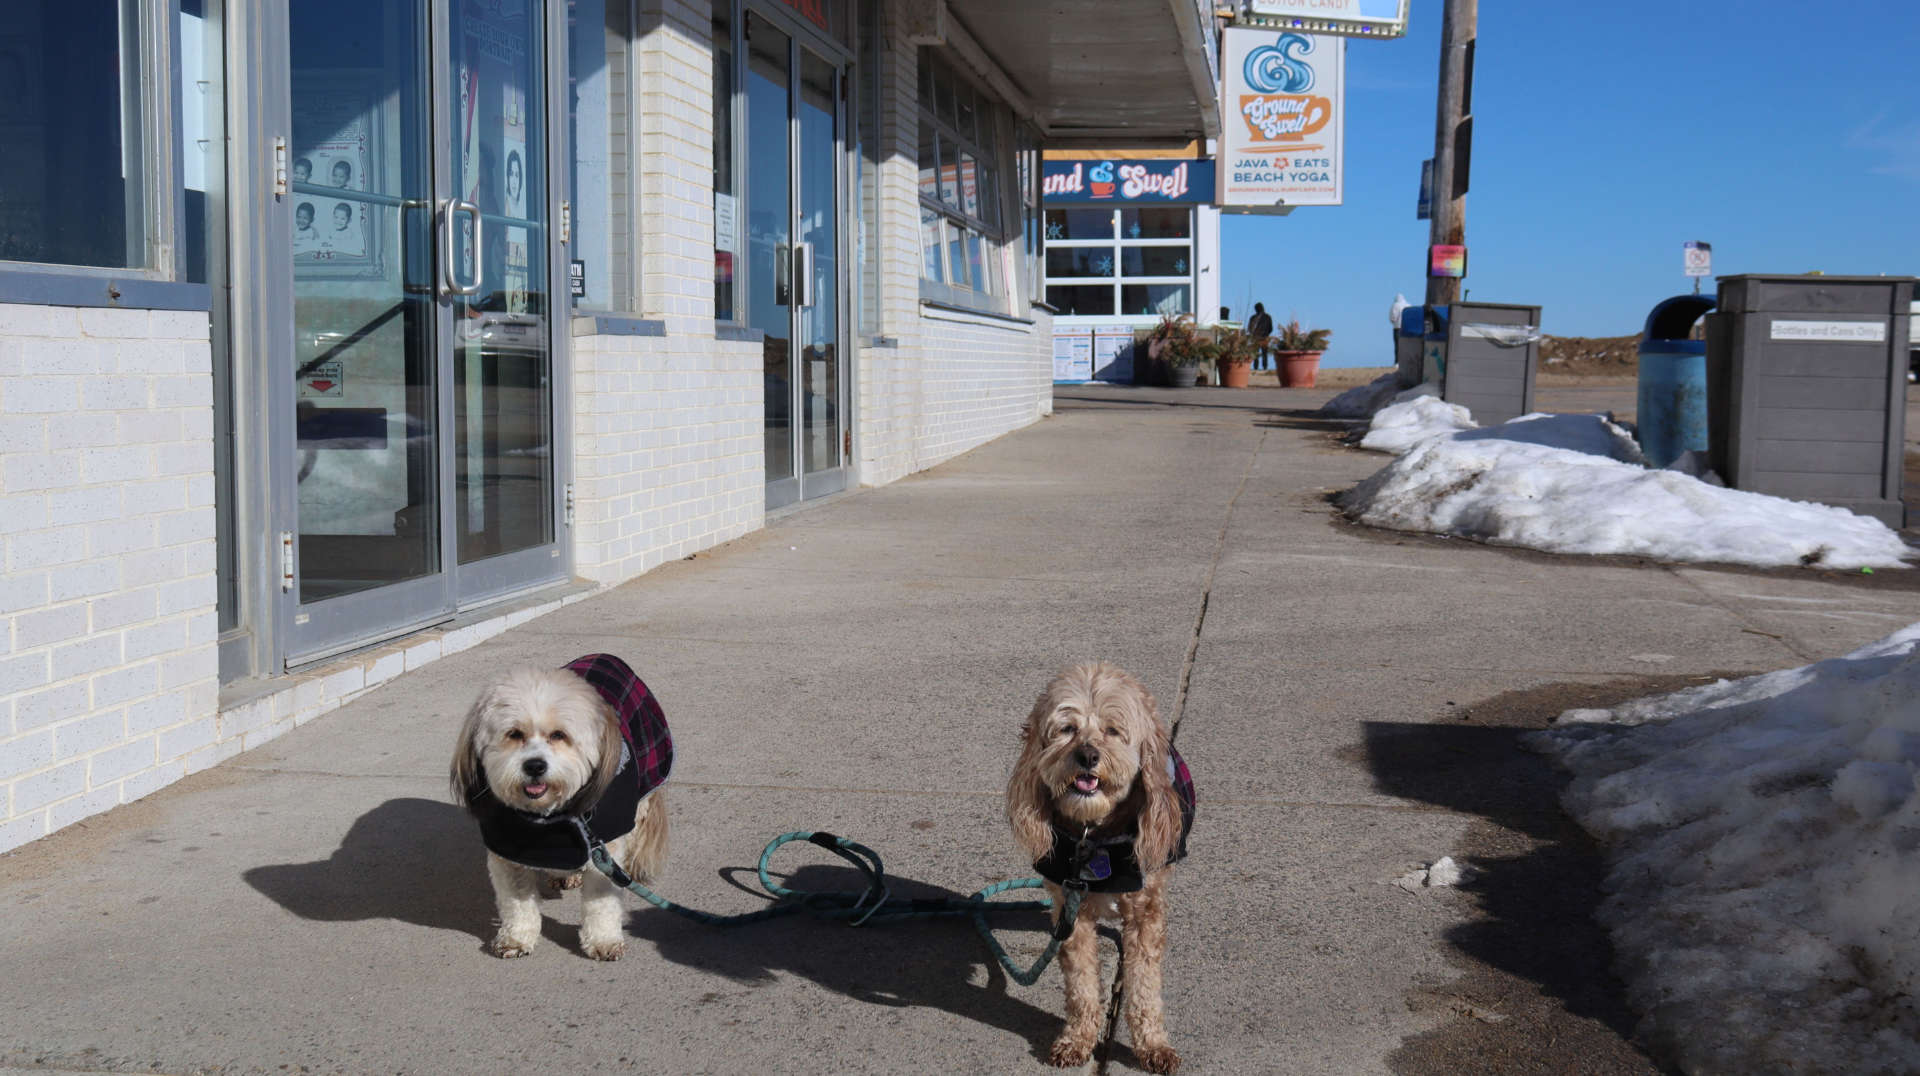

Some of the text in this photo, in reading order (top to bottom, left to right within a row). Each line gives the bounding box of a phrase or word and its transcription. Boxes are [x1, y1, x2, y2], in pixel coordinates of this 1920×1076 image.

[1242, 97, 1310, 125] Ground
[1259, 113, 1308, 140] Swell
[1234, 159, 1329, 168] JAVA EATS
[1118, 162, 1189, 199] Swell
[1233, 172, 1330, 182] BEACH YOGA
[1811, 325, 1828, 335] and
[1831, 326, 1854, 336] Cans
